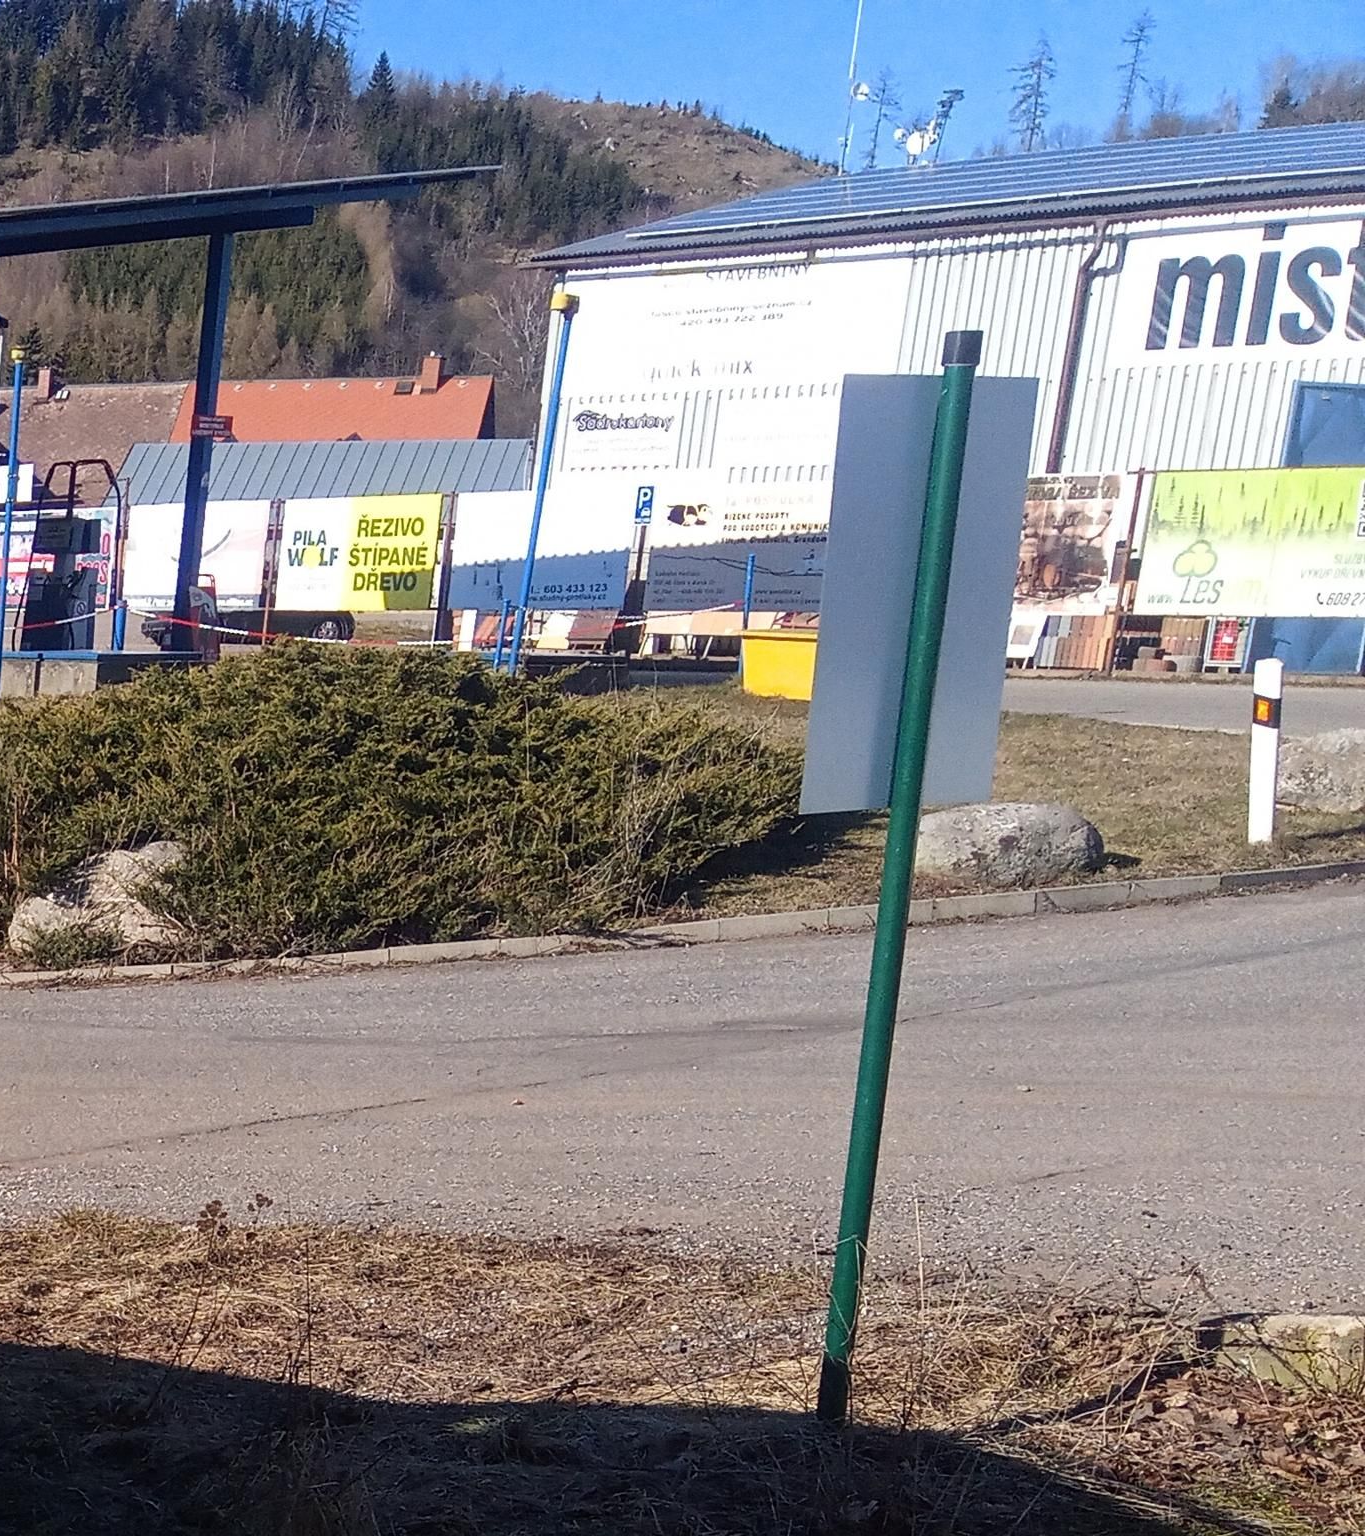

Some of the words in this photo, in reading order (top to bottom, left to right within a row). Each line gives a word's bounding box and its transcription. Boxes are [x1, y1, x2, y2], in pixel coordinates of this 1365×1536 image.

[357, 514, 424, 538] ŘEZIVO
[349, 542, 428, 567] ŠTÍPANÉ
[353, 568, 417, 591] DŘEVO
[543, 584, 563, 594] 603
[589, 582, 608, 593] 123
